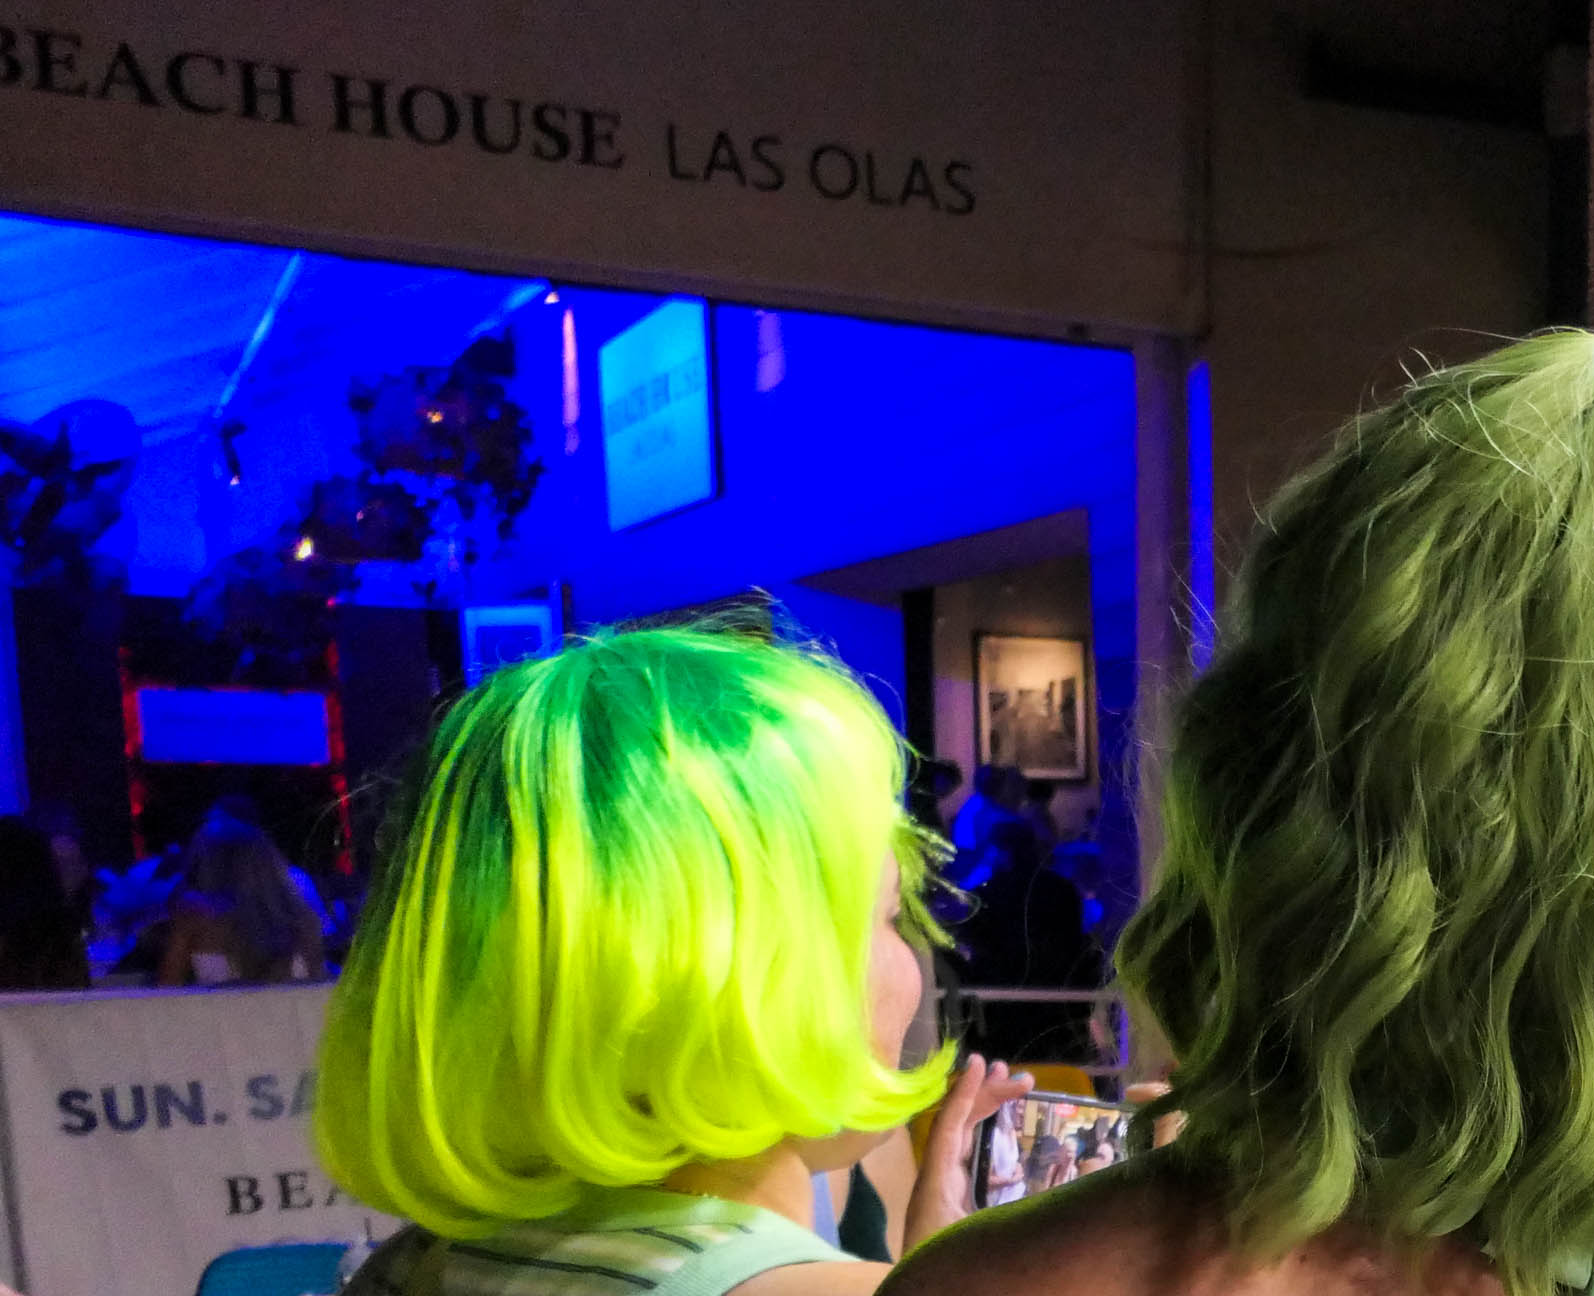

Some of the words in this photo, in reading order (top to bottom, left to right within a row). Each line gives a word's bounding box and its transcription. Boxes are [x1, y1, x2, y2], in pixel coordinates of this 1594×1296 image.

[328, 71, 626, 170] HOUSE
[665, 122, 787, 192] LAS
[809, 143, 977, 215] OLAS
[57, 1079, 229, 1137] SUN.
[223, 1170, 343, 1217] BE
